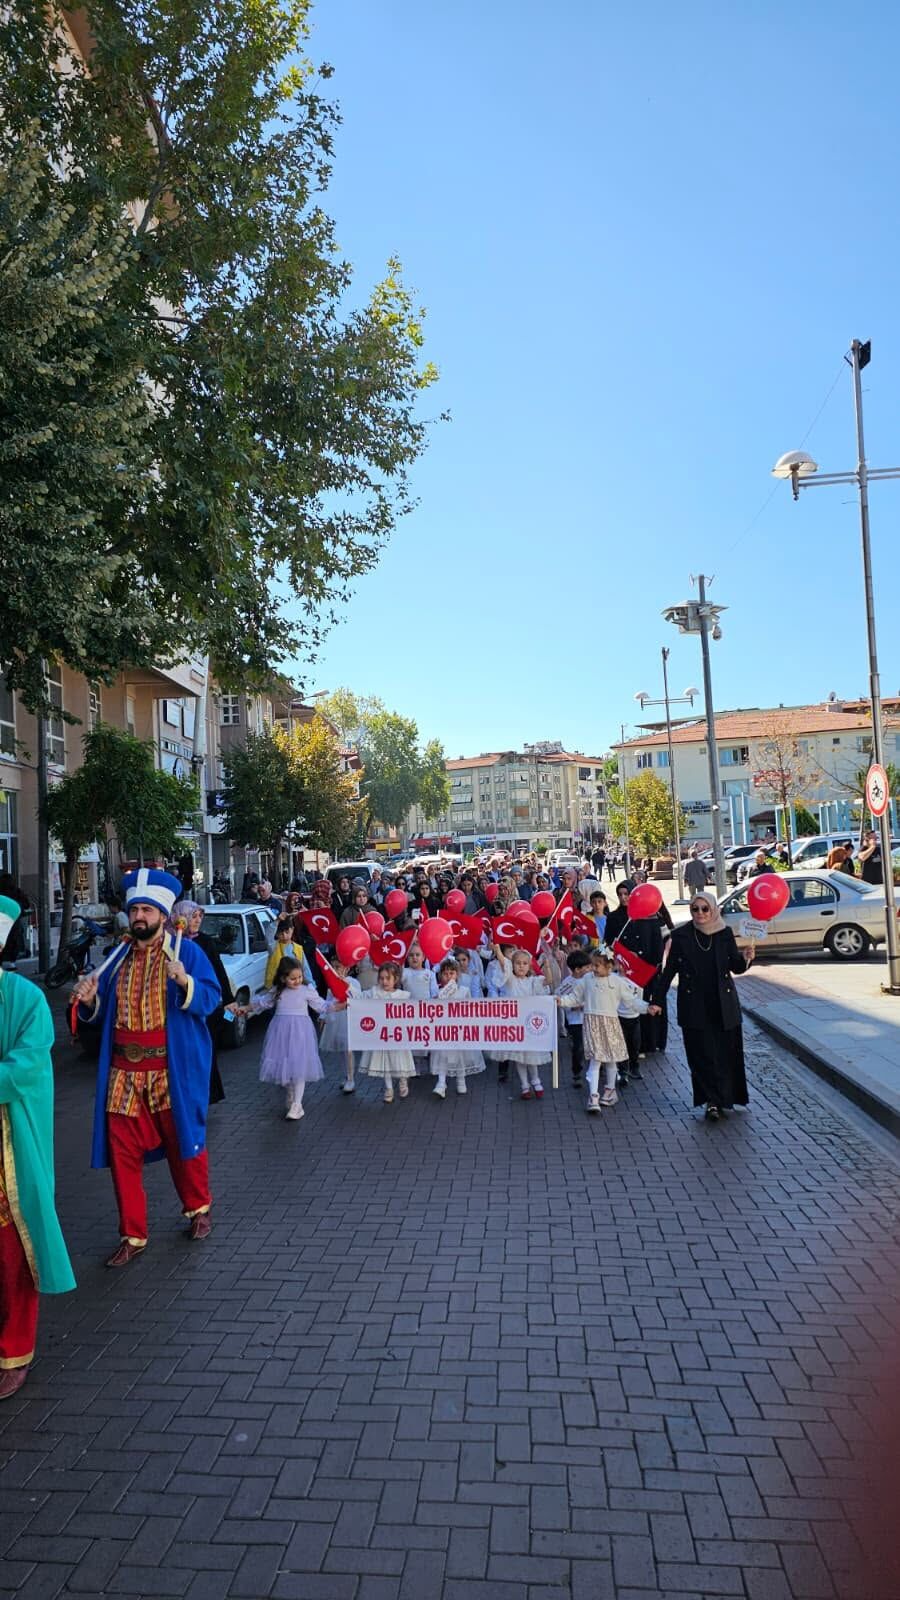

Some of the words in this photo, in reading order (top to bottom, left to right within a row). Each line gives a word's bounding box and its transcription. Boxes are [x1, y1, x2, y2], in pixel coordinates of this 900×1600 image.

[385, 1002, 414, 1019] Kula
[418, 1000, 444, 1023] İlçe
[449, 1000, 518, 1020] Müftülüğü
[380, 1026, 402, 1042] 4-6
[407, 1025, 430, 1047] YAŞ
[434, 1025, 480, 1042] KUR'AN
[484, 1025, 525, 1042] KURSU
